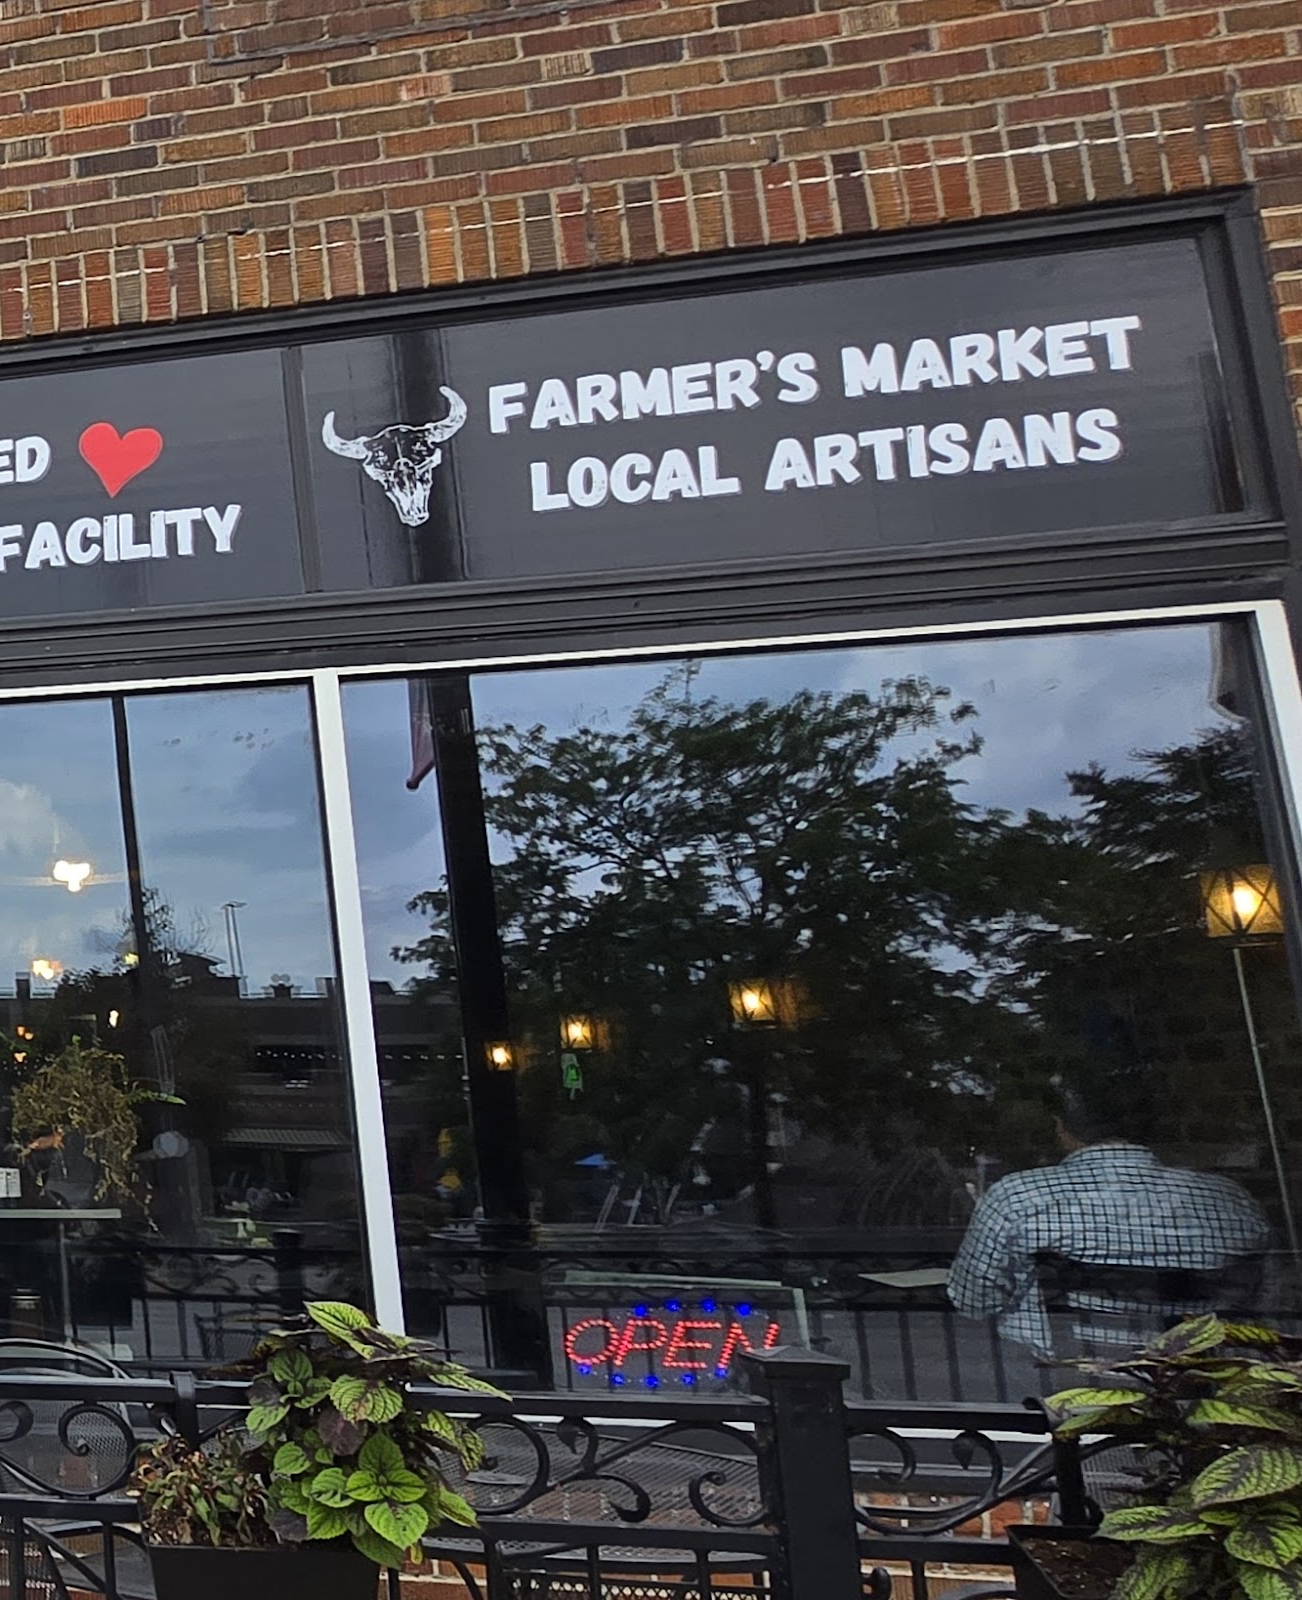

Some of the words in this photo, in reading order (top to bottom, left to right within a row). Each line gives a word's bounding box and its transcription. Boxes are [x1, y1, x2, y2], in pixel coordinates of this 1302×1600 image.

[488, 350, 818, 434] FARMER'S
[841, 316, 1141, 398] MARKET
[530, 445, 741, 512] LOCAL
[765, 408, 1124, 493] ARTISANS
[566, 1318, 779, 1369] OPEN
